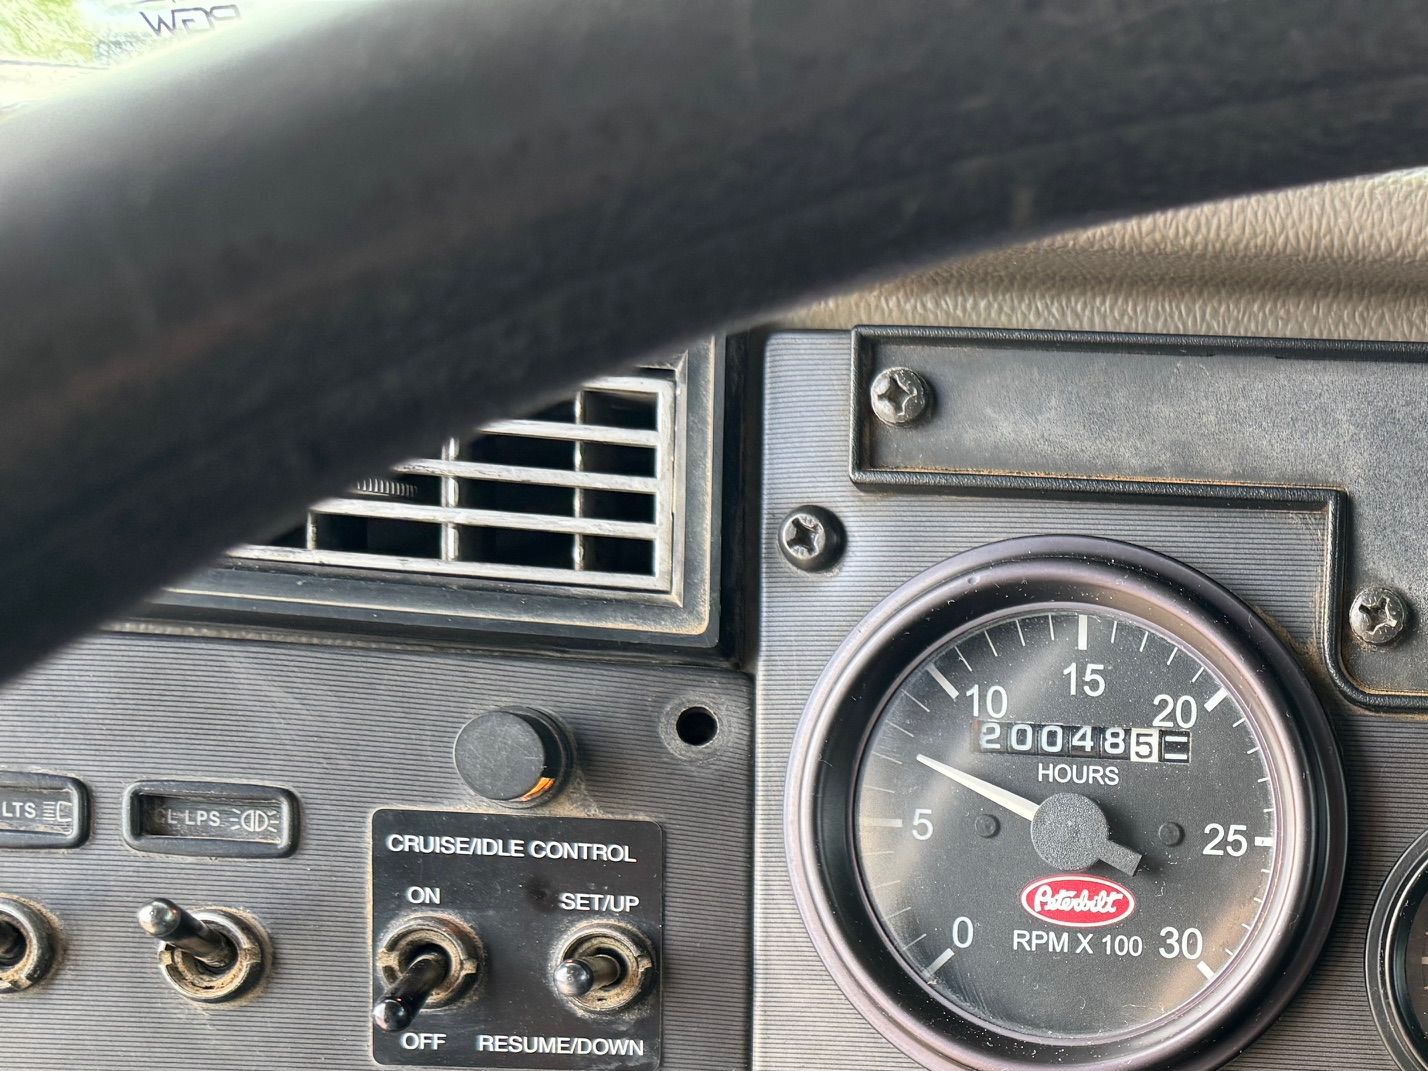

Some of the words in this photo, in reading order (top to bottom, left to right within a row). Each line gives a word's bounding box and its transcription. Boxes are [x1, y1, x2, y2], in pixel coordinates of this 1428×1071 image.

[1063, 662, 1105, 697] 15
[966, 684, 1008, 719] 10
[1152, 694, 1198, 728] 20
[1038, 763, 1119, 785] HOURS
[185, 809, 220, 827] LPS
[911, 808, 934, 840] 5
[386, 834, 524, 858] CRUISE/IDLE
[530, 840, 637, 863] CONTROL
[1202, 823, 1248, 857] 25
[406, 886, 441, 904] ON
[560, 893, 640, 912] SET/UP
[1034, 884, 1124, 915] Peterbilt
[952, 917, 974, 948] 0
[1013, 930, 1072, 953] RPM
[1075, 933, 1096, 954] X
[1102, 934, 1143, 957] 100
[1159, 926, 1203, 960] 30
[401, 1033, 447, 1050] OFF
[477, 1035, 644, 1056] RESUME/DOWN
